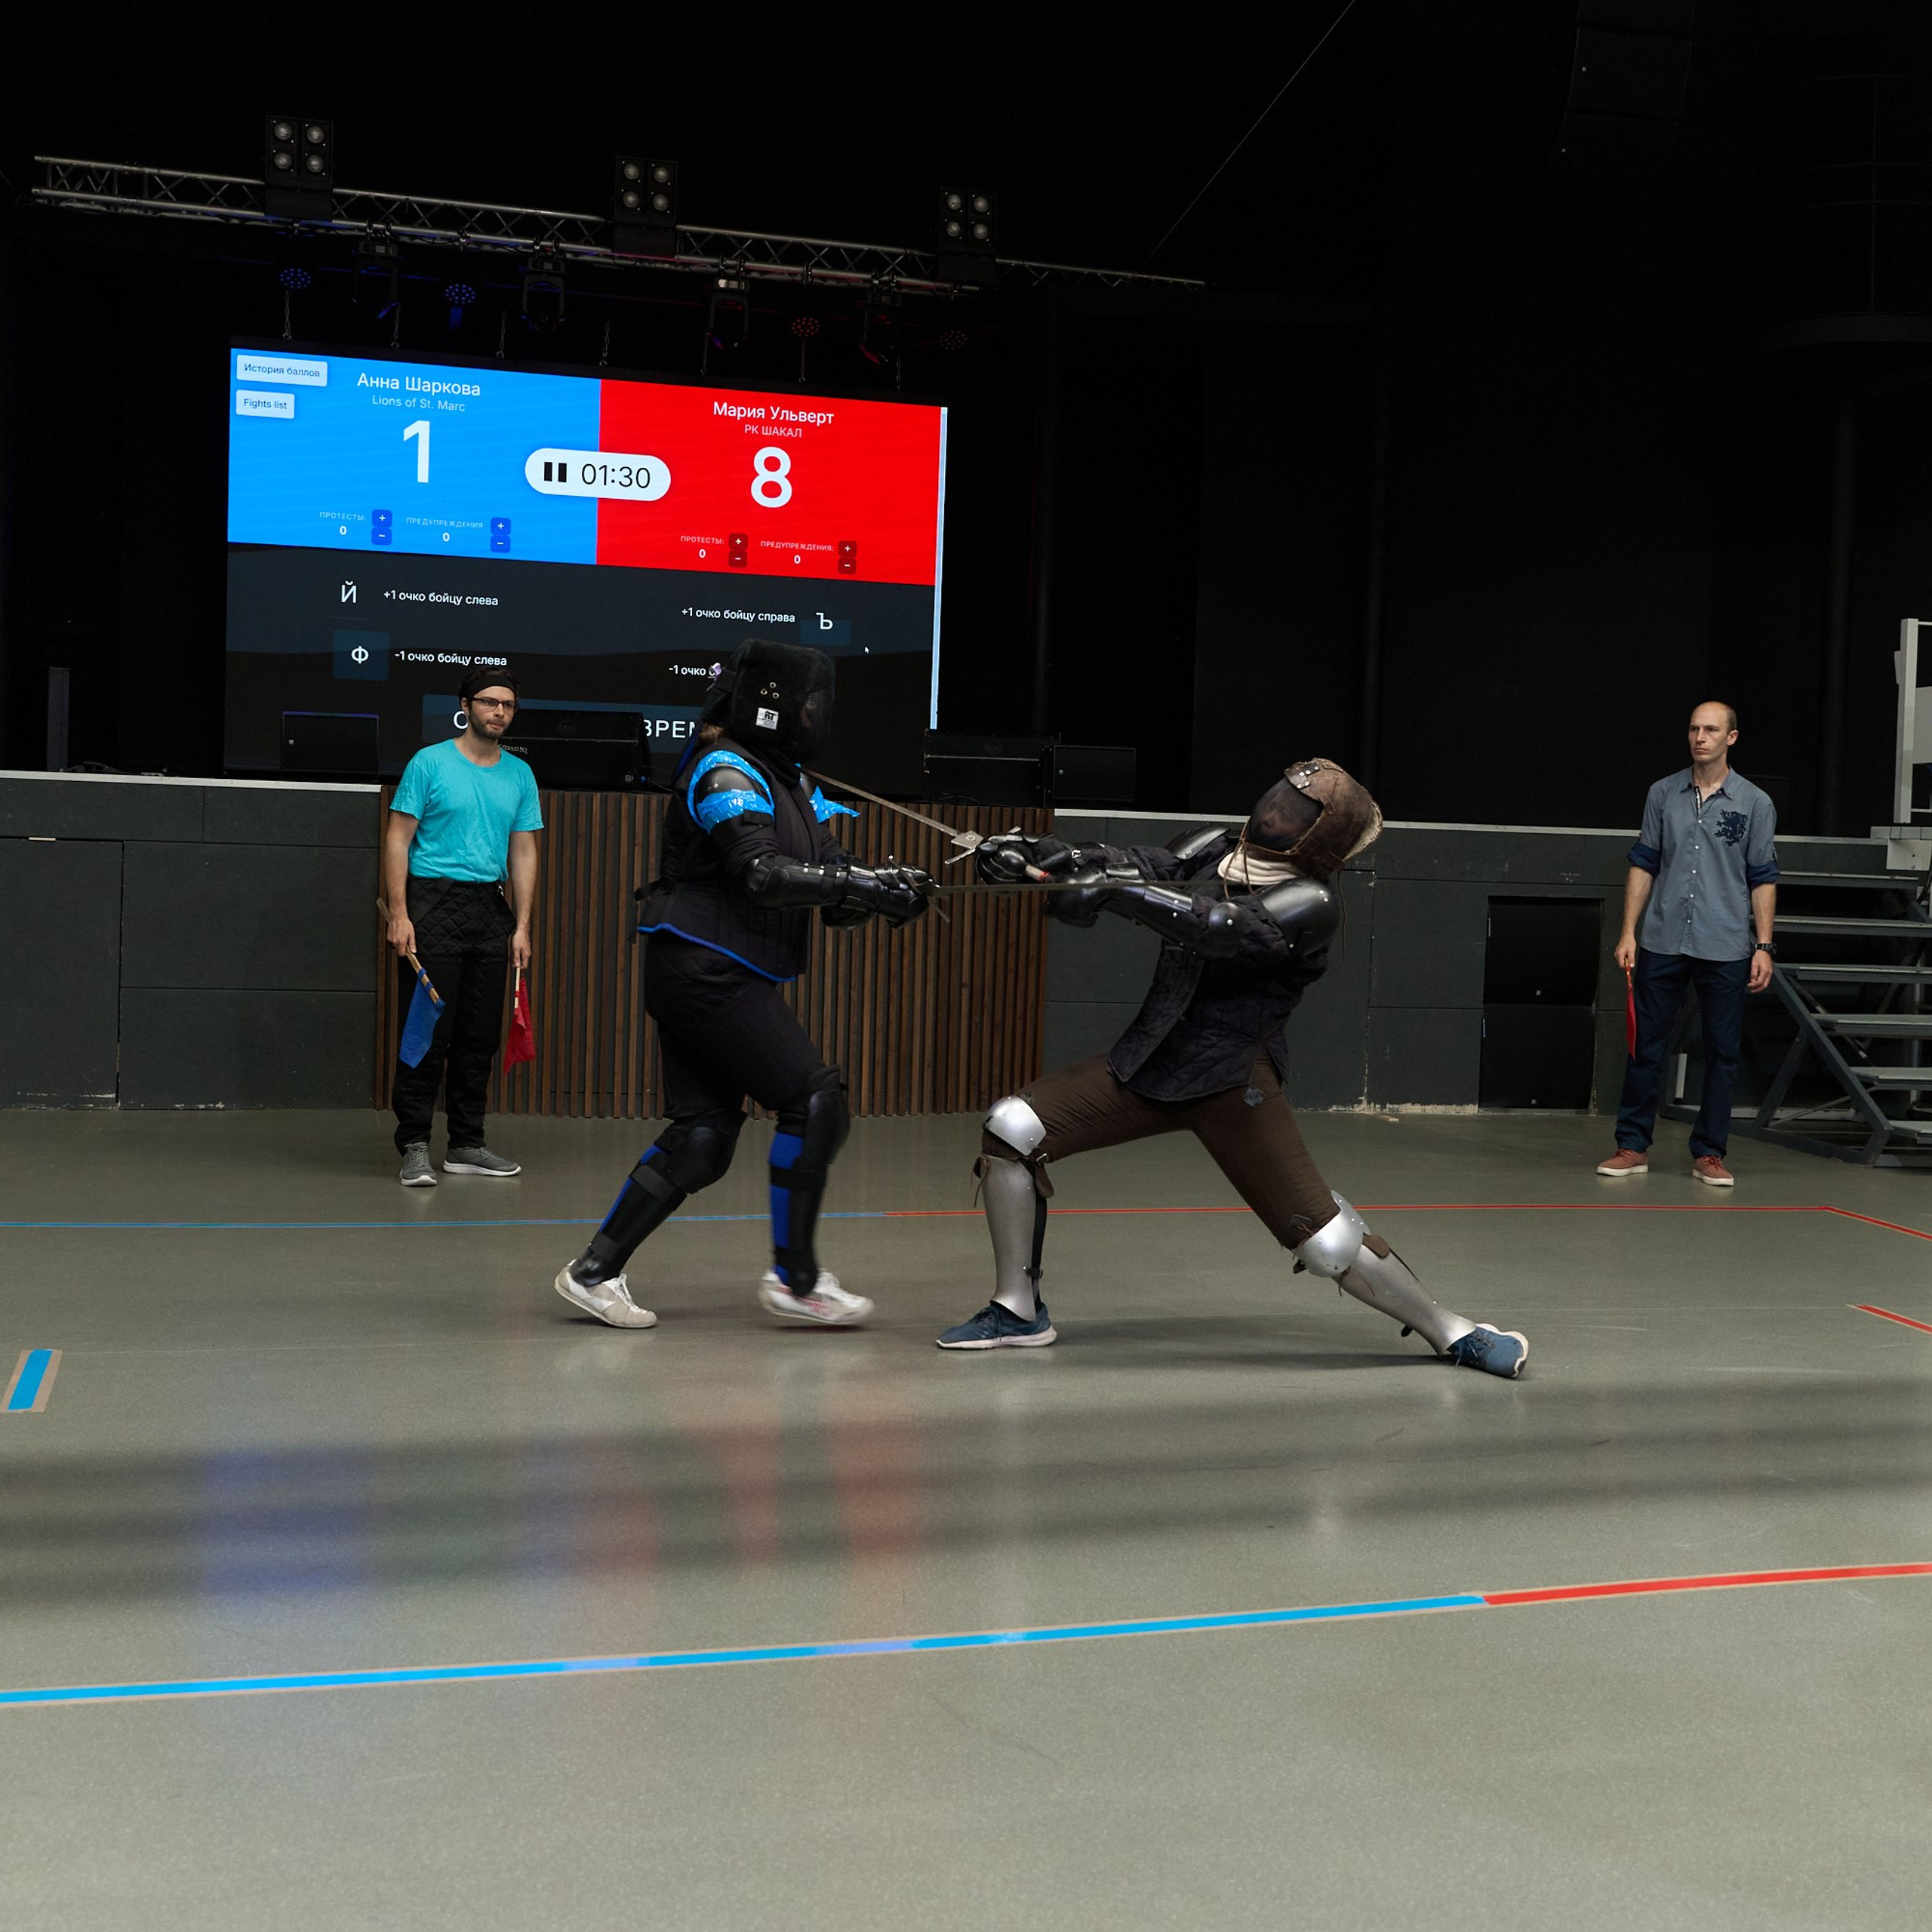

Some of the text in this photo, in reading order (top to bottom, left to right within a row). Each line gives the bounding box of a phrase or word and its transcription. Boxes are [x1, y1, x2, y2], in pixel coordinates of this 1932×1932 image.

[244, 364, 320, 377] История баллов
[357, 374, 480, 396] Анна Шаркова
[244, 398, 287, 409] Fights list
[372, 395, 466, 411] Lions of St. Marc
[713, 401, 834, 426] Мария Ульверт
[744, 424, 801, 438] РК ШАКАЛ
[403, 420, 430, 483] 1
[581, 460, 651, 490] 01:30
[750, 446, 792, 508] 8
[340, 525, 347, 535] 0
[442, 532, 451, 542] 0
[680, 535, 724, 545] ПРОТЕСТЫ:
[760, 540, 834, 552] ПРЕДУПРЕЖДЕНИЯ:
[699, 549, 706, 558] 0
[793, 555, 801, 565] 0
[340, 580, 356, 604] Й
[383, 590, 499, 606] +1 очко бойцу слева
[681, 607, 795, 625] +1 очко бойцу справа
[816, 612, 832, 630] Ъ
[351, 645, 369, 664] Ф
[395, 651, 507, 666] -1 очко бойцу слева
[669, 665, 678, 675] -1
[681, 666, 706, 676] очко
